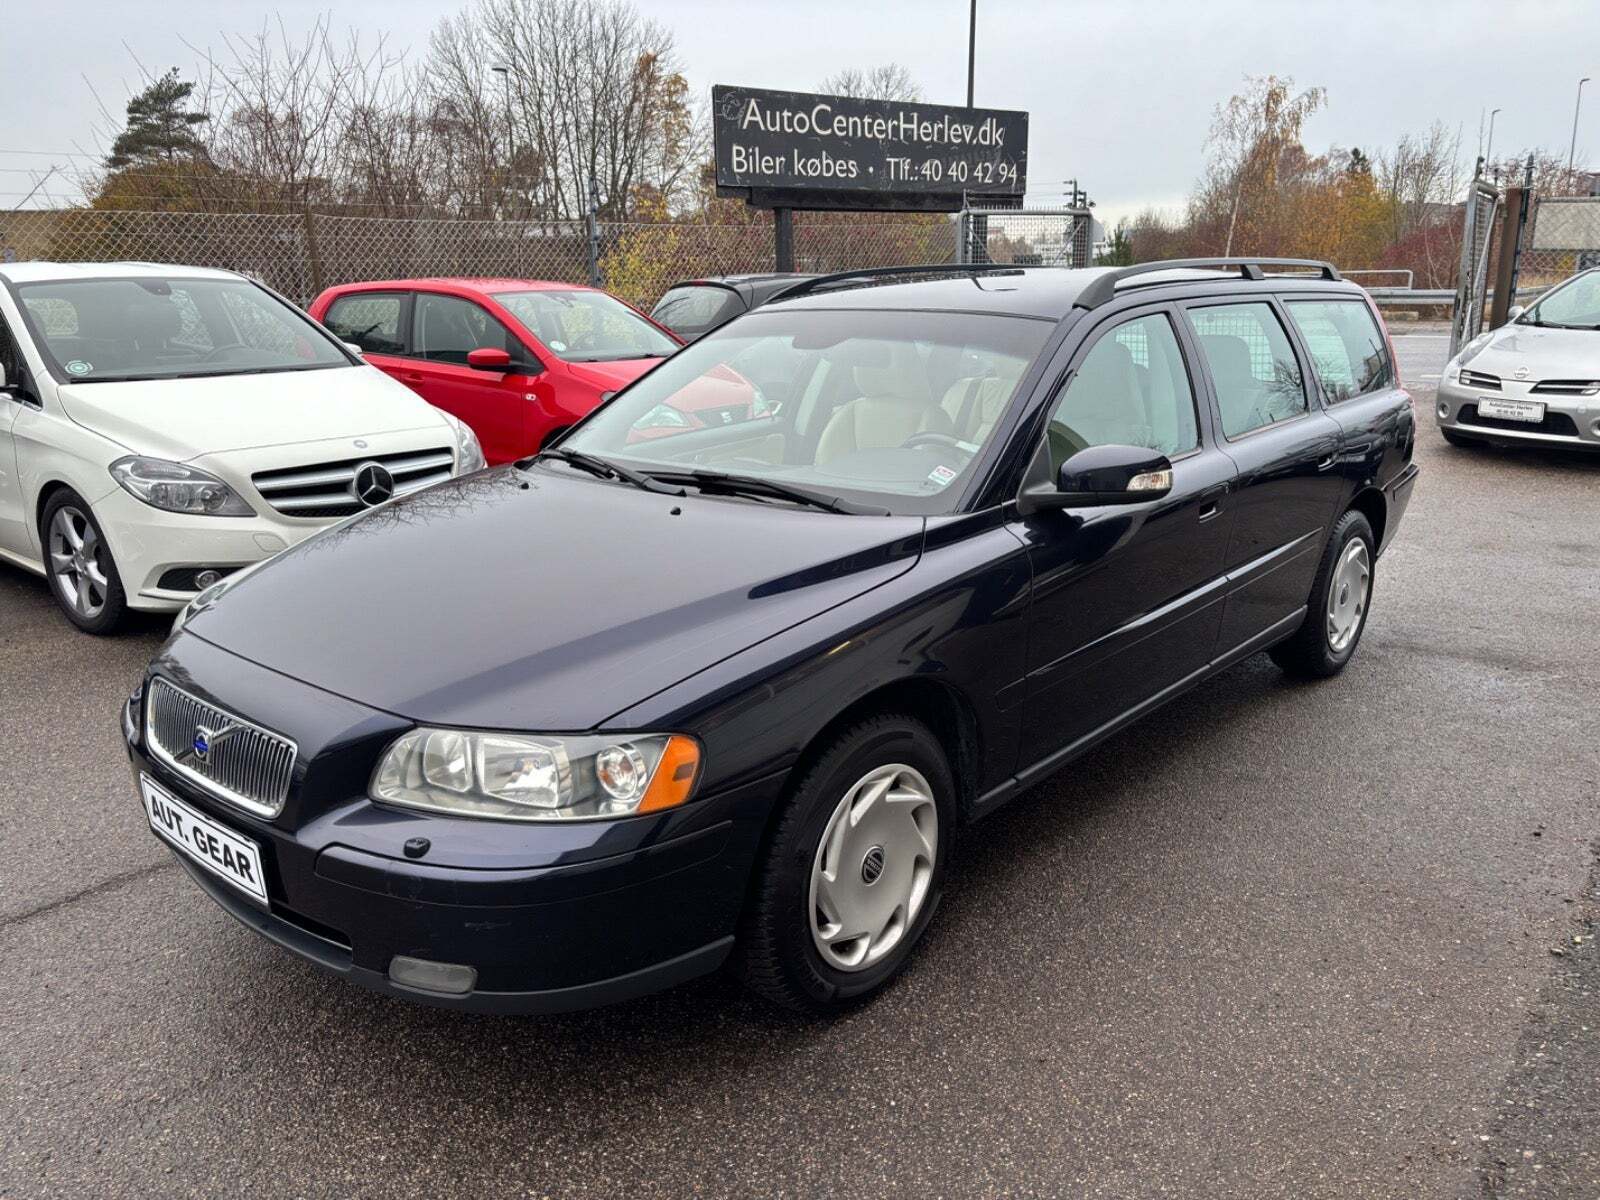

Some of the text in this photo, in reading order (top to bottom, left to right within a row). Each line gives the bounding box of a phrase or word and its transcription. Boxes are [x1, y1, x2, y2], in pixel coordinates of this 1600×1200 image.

[742, 98, 1004, 146] AutoCenterHerlev.dk
[732, 143, 786, 174] Biler
[794, 148, 857, 178] købes
[947, 161, 968, 182] 40
[973, 162, 993, 183] 42
[999, 163, 1017, 186] 94
[151, 796, 255, 883] AUT. GEAR
